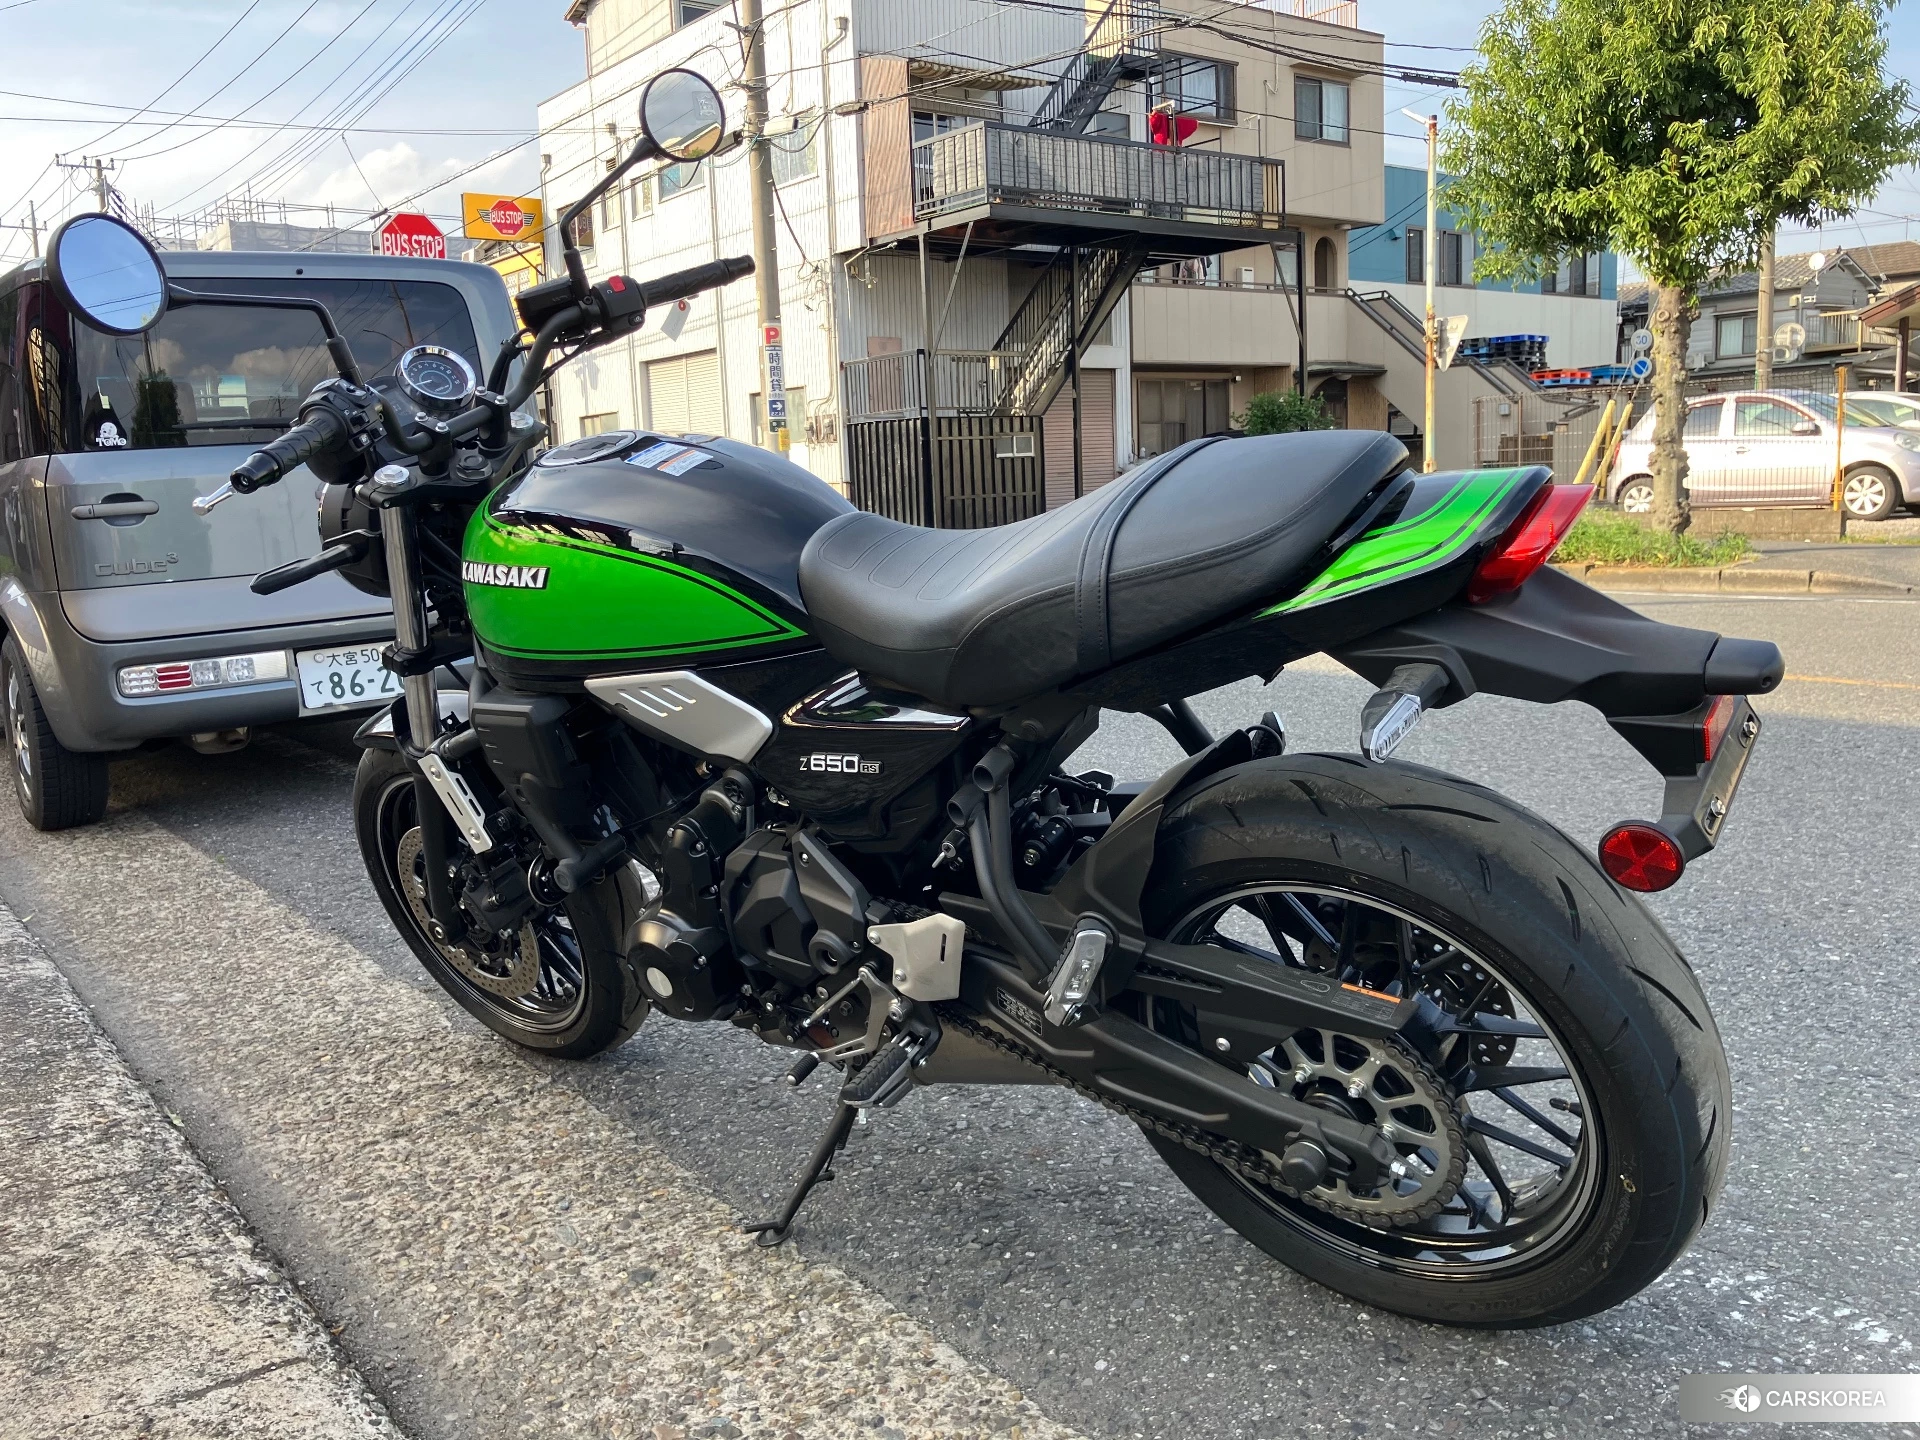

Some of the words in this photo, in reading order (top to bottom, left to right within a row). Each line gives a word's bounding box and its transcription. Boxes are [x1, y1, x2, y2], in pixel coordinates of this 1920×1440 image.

[491, 210, 506, 224] BUS
[506, 211, 523, 226] STOP
[383, 232, 410, 256] BUS
[411, 235, 443, 258] STOP
[635, 335, 648, 345] 30
[765, 327, 780, 345] P
[768, 351, 783, 392] 時間貸
[462, 561, 548, 588] KAWASAKI
[326, 651, 358, 667] 大宮
[361, 648, 382, 663] 50
[310, 680, 323, 694] て
